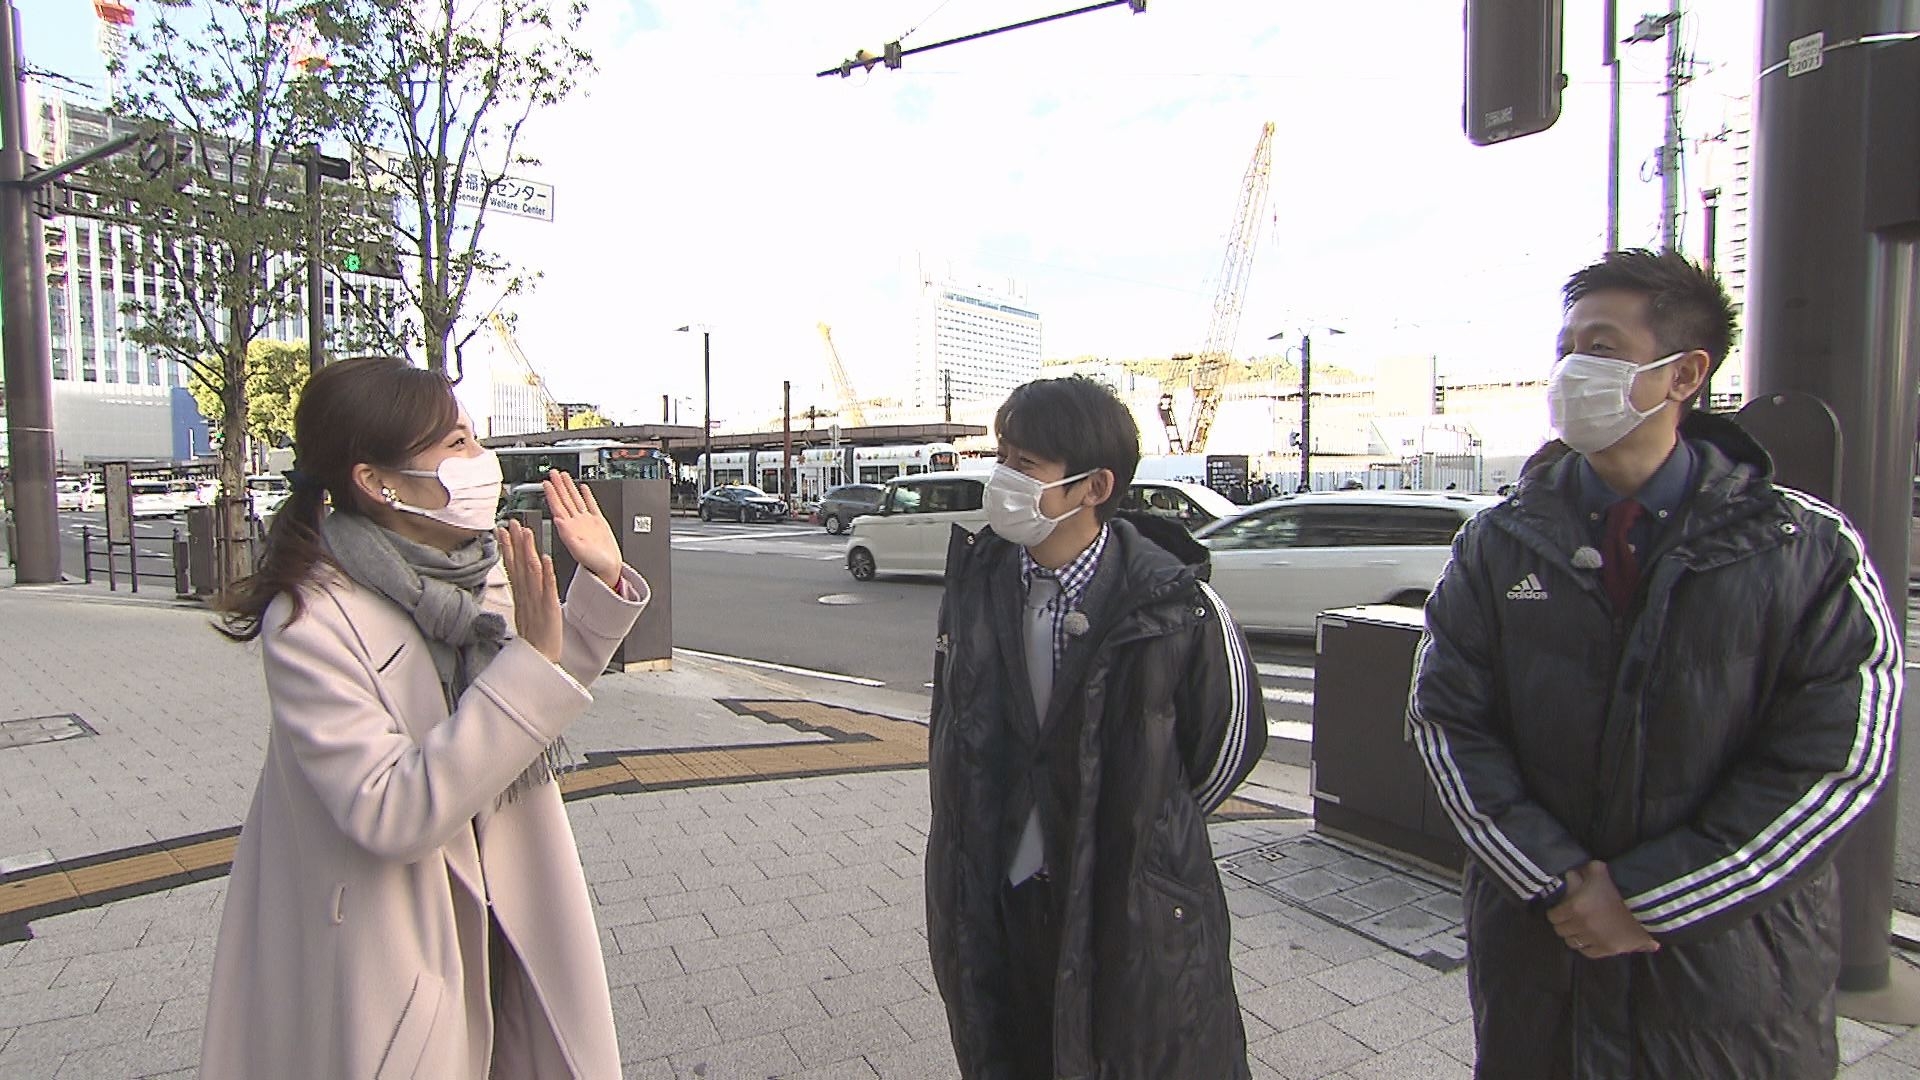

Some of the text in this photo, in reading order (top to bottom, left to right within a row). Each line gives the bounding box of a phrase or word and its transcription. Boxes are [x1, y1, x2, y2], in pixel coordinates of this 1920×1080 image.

[387, 157, 547, 201] 広福センター
[489, 197, 519, 211] Welfare
[522, 203, 547, 216] Center
[1506, 589, 1548, 600] adidas
